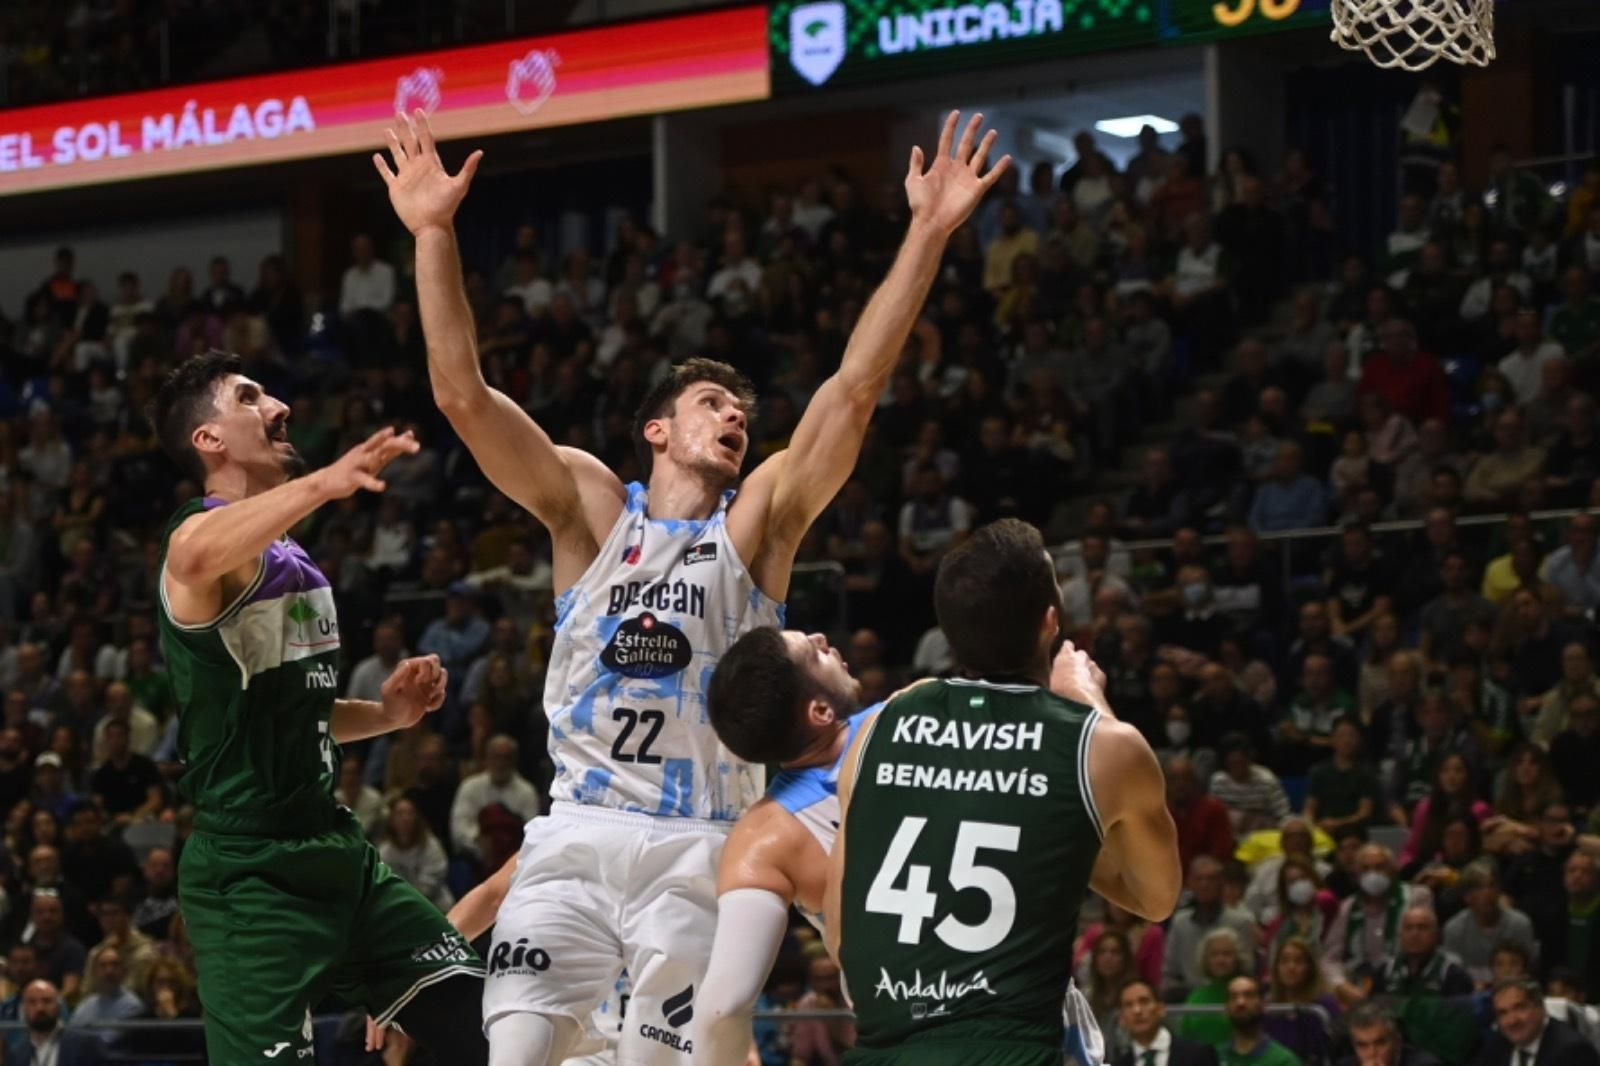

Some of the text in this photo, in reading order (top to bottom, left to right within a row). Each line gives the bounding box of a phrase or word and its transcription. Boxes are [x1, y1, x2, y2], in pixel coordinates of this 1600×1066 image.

[878, 0, 1064, 54] UNICAJA
[52, 120, 133, 166] SOL
[142, 95, 315, 153] MÁLAGA
[614, 630, 678, 649] Estrella
[615, 647, 673, 665] Galicia
[611, 707, 665, 764] 22
[892, 715, 1043, 750] KRAVISH
[876, 763, 1049, 797] BENAHAVÍS
[865, 816, 1021, 953] 45
[874, 966, 997, 1001] Andalucía
[640, 1024, 693, 1054] CANDELA
